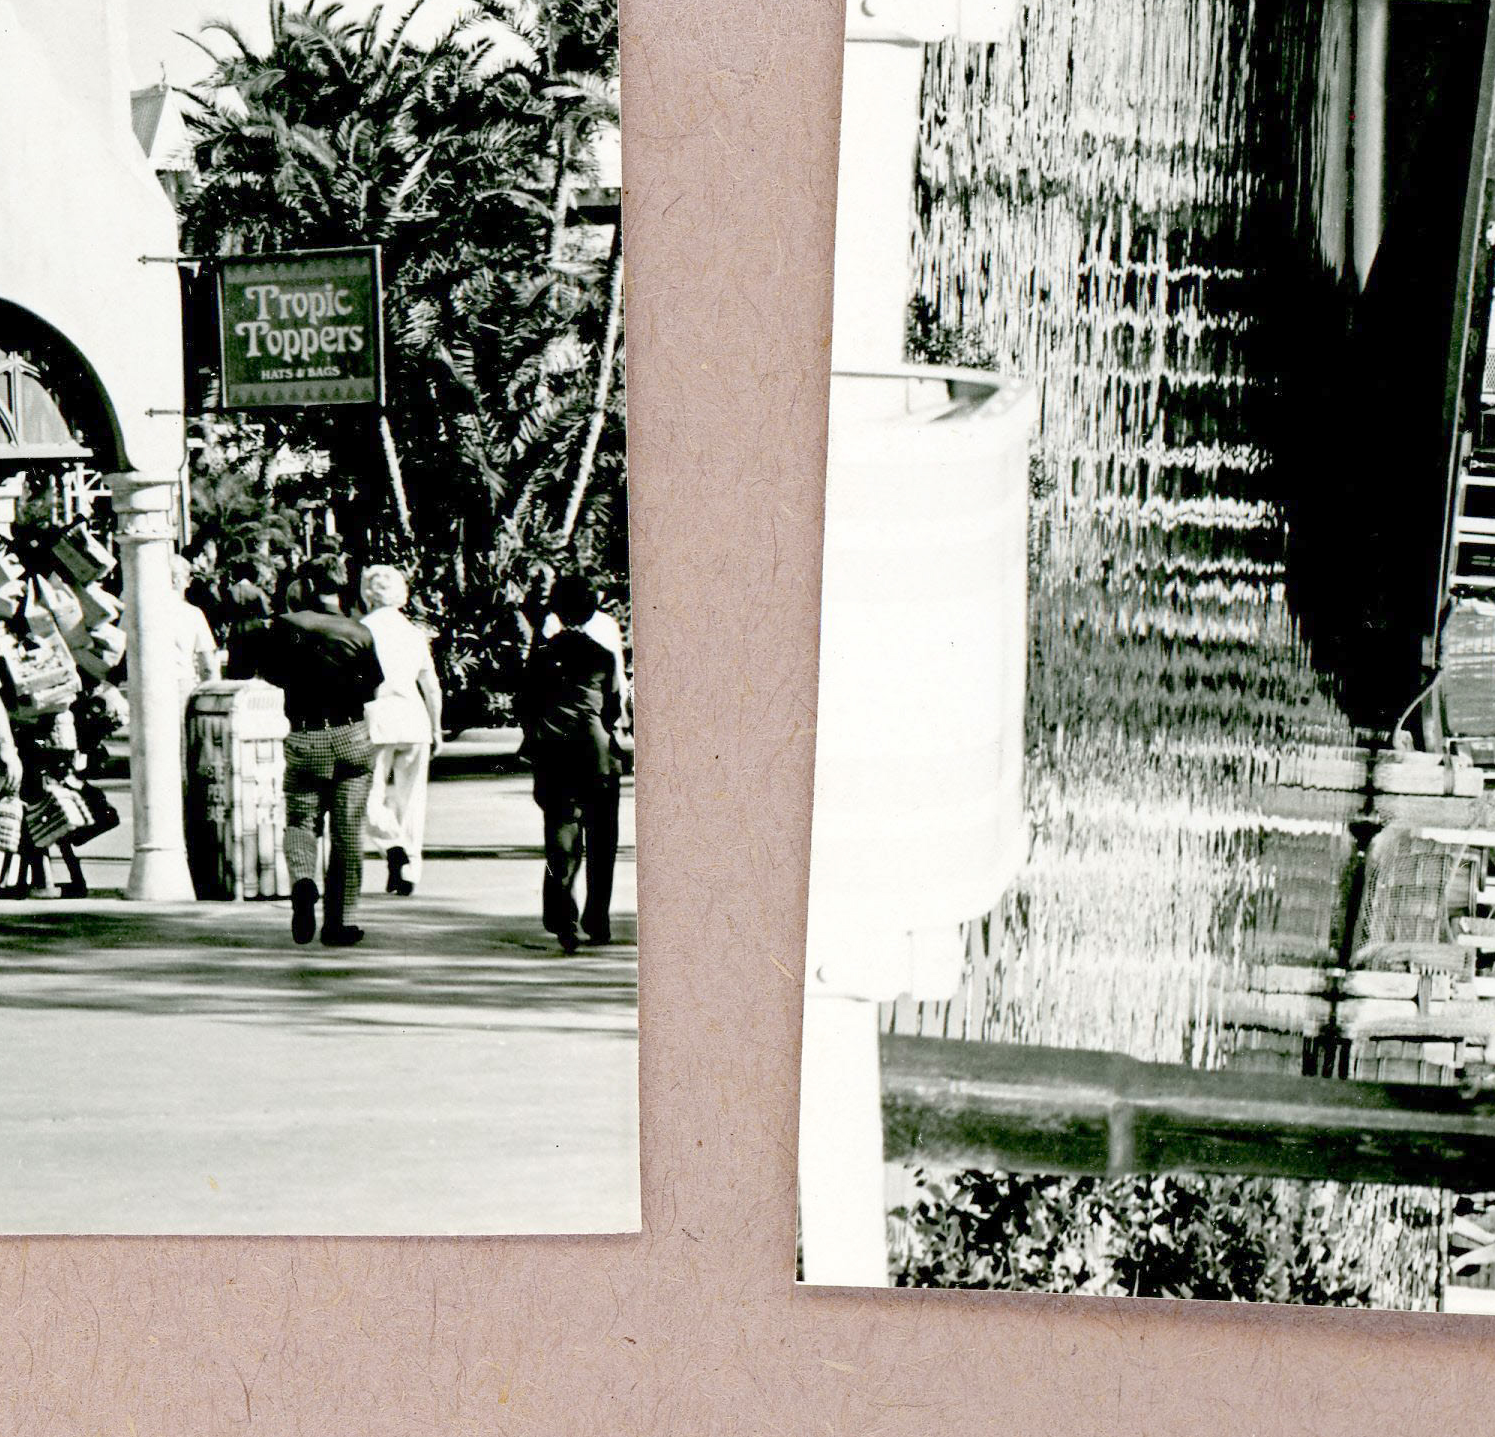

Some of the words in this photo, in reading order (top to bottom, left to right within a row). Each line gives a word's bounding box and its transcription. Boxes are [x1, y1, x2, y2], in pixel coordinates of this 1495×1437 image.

[244, 283, 354, 326] Tropic
[234, 321, 365, 364] Toppers
[261, 368, 294, 381] HATS
[307, 366, 341, 378] BAGS
